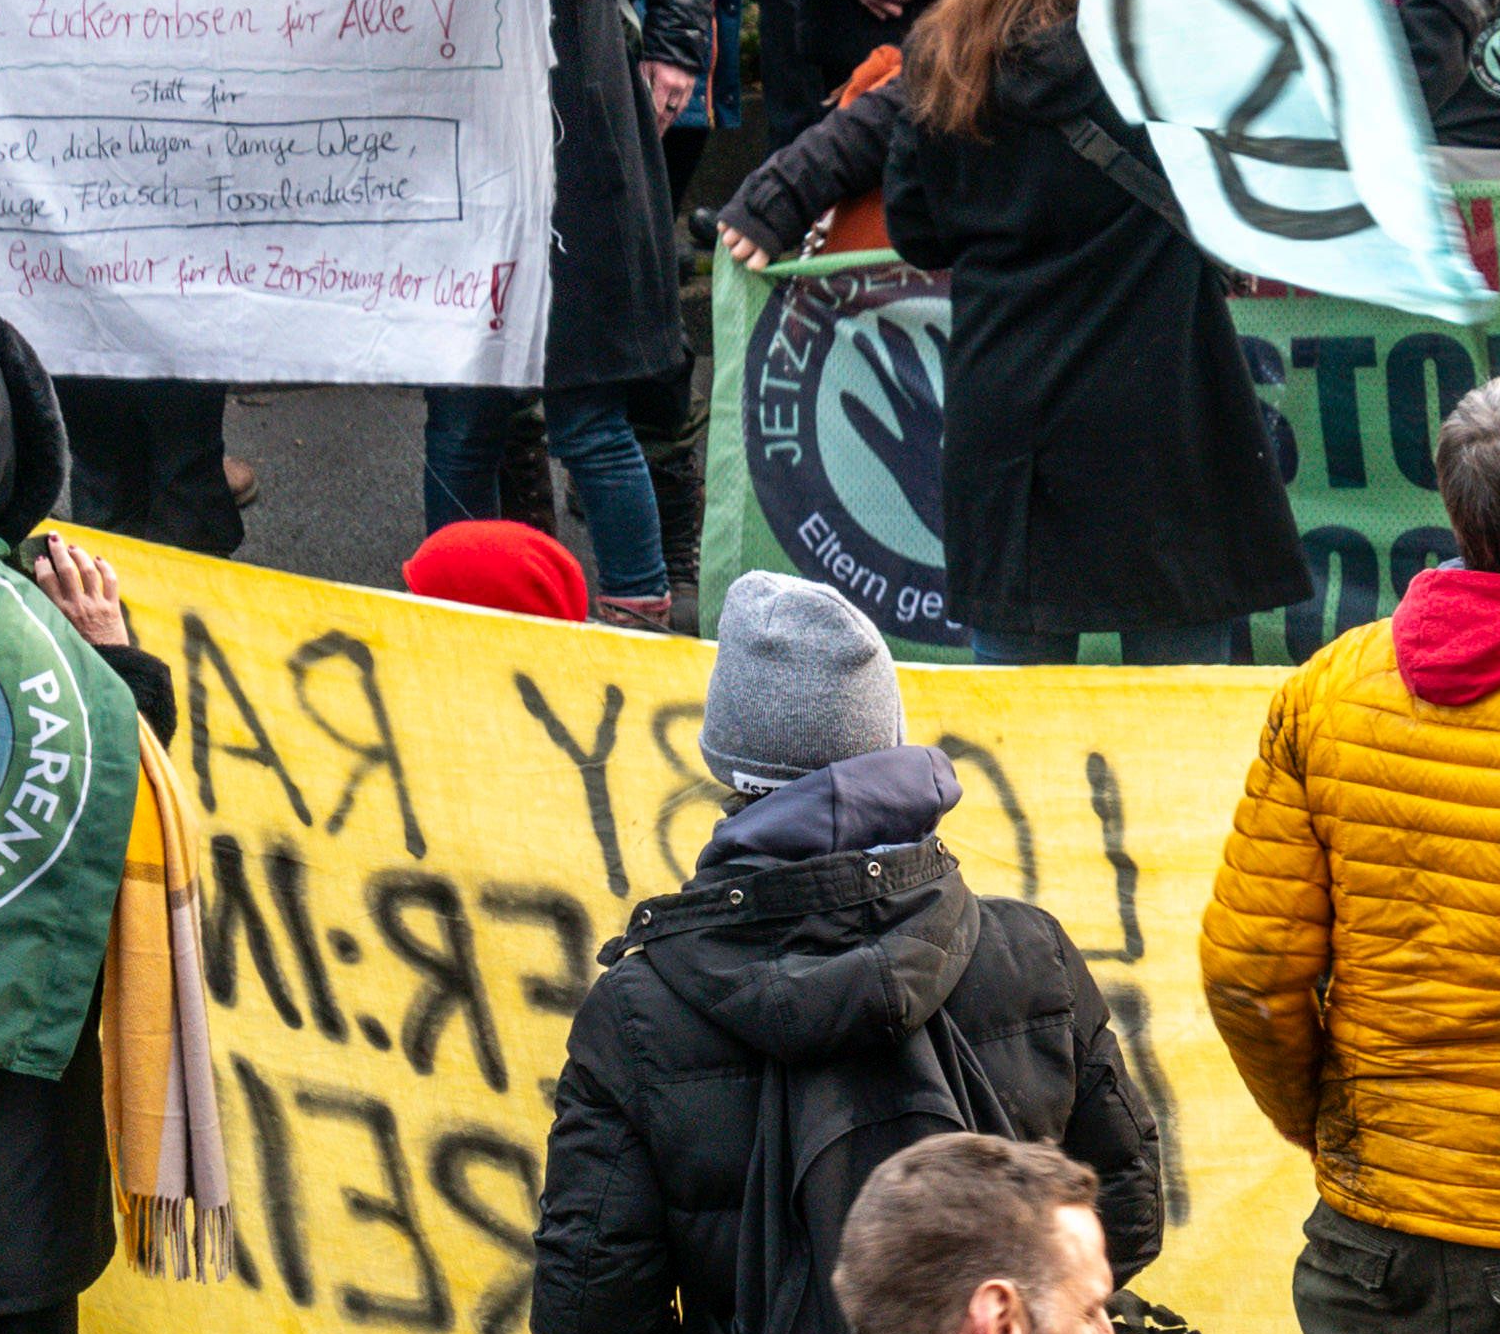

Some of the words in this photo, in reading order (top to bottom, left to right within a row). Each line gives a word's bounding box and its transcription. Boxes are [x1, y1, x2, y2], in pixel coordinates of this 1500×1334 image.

[276, 6, 325, 52] für
[203, 84, 248, 121] für
[61, 126, 122, 164] dicke
[224, 126, 306, 169] lange
[208, 172, 411, 219] Fossilindustrie
[6, 239, 73, 297] Geld
[84, 247, 171, 287] mehr
[173, 247, 217, 296] für
[217, 248, 259, 287] die
[388, 264, 425, 303] der
[796, 511, 890, 604] Eltern
[897, 586, 962, 629] ge
